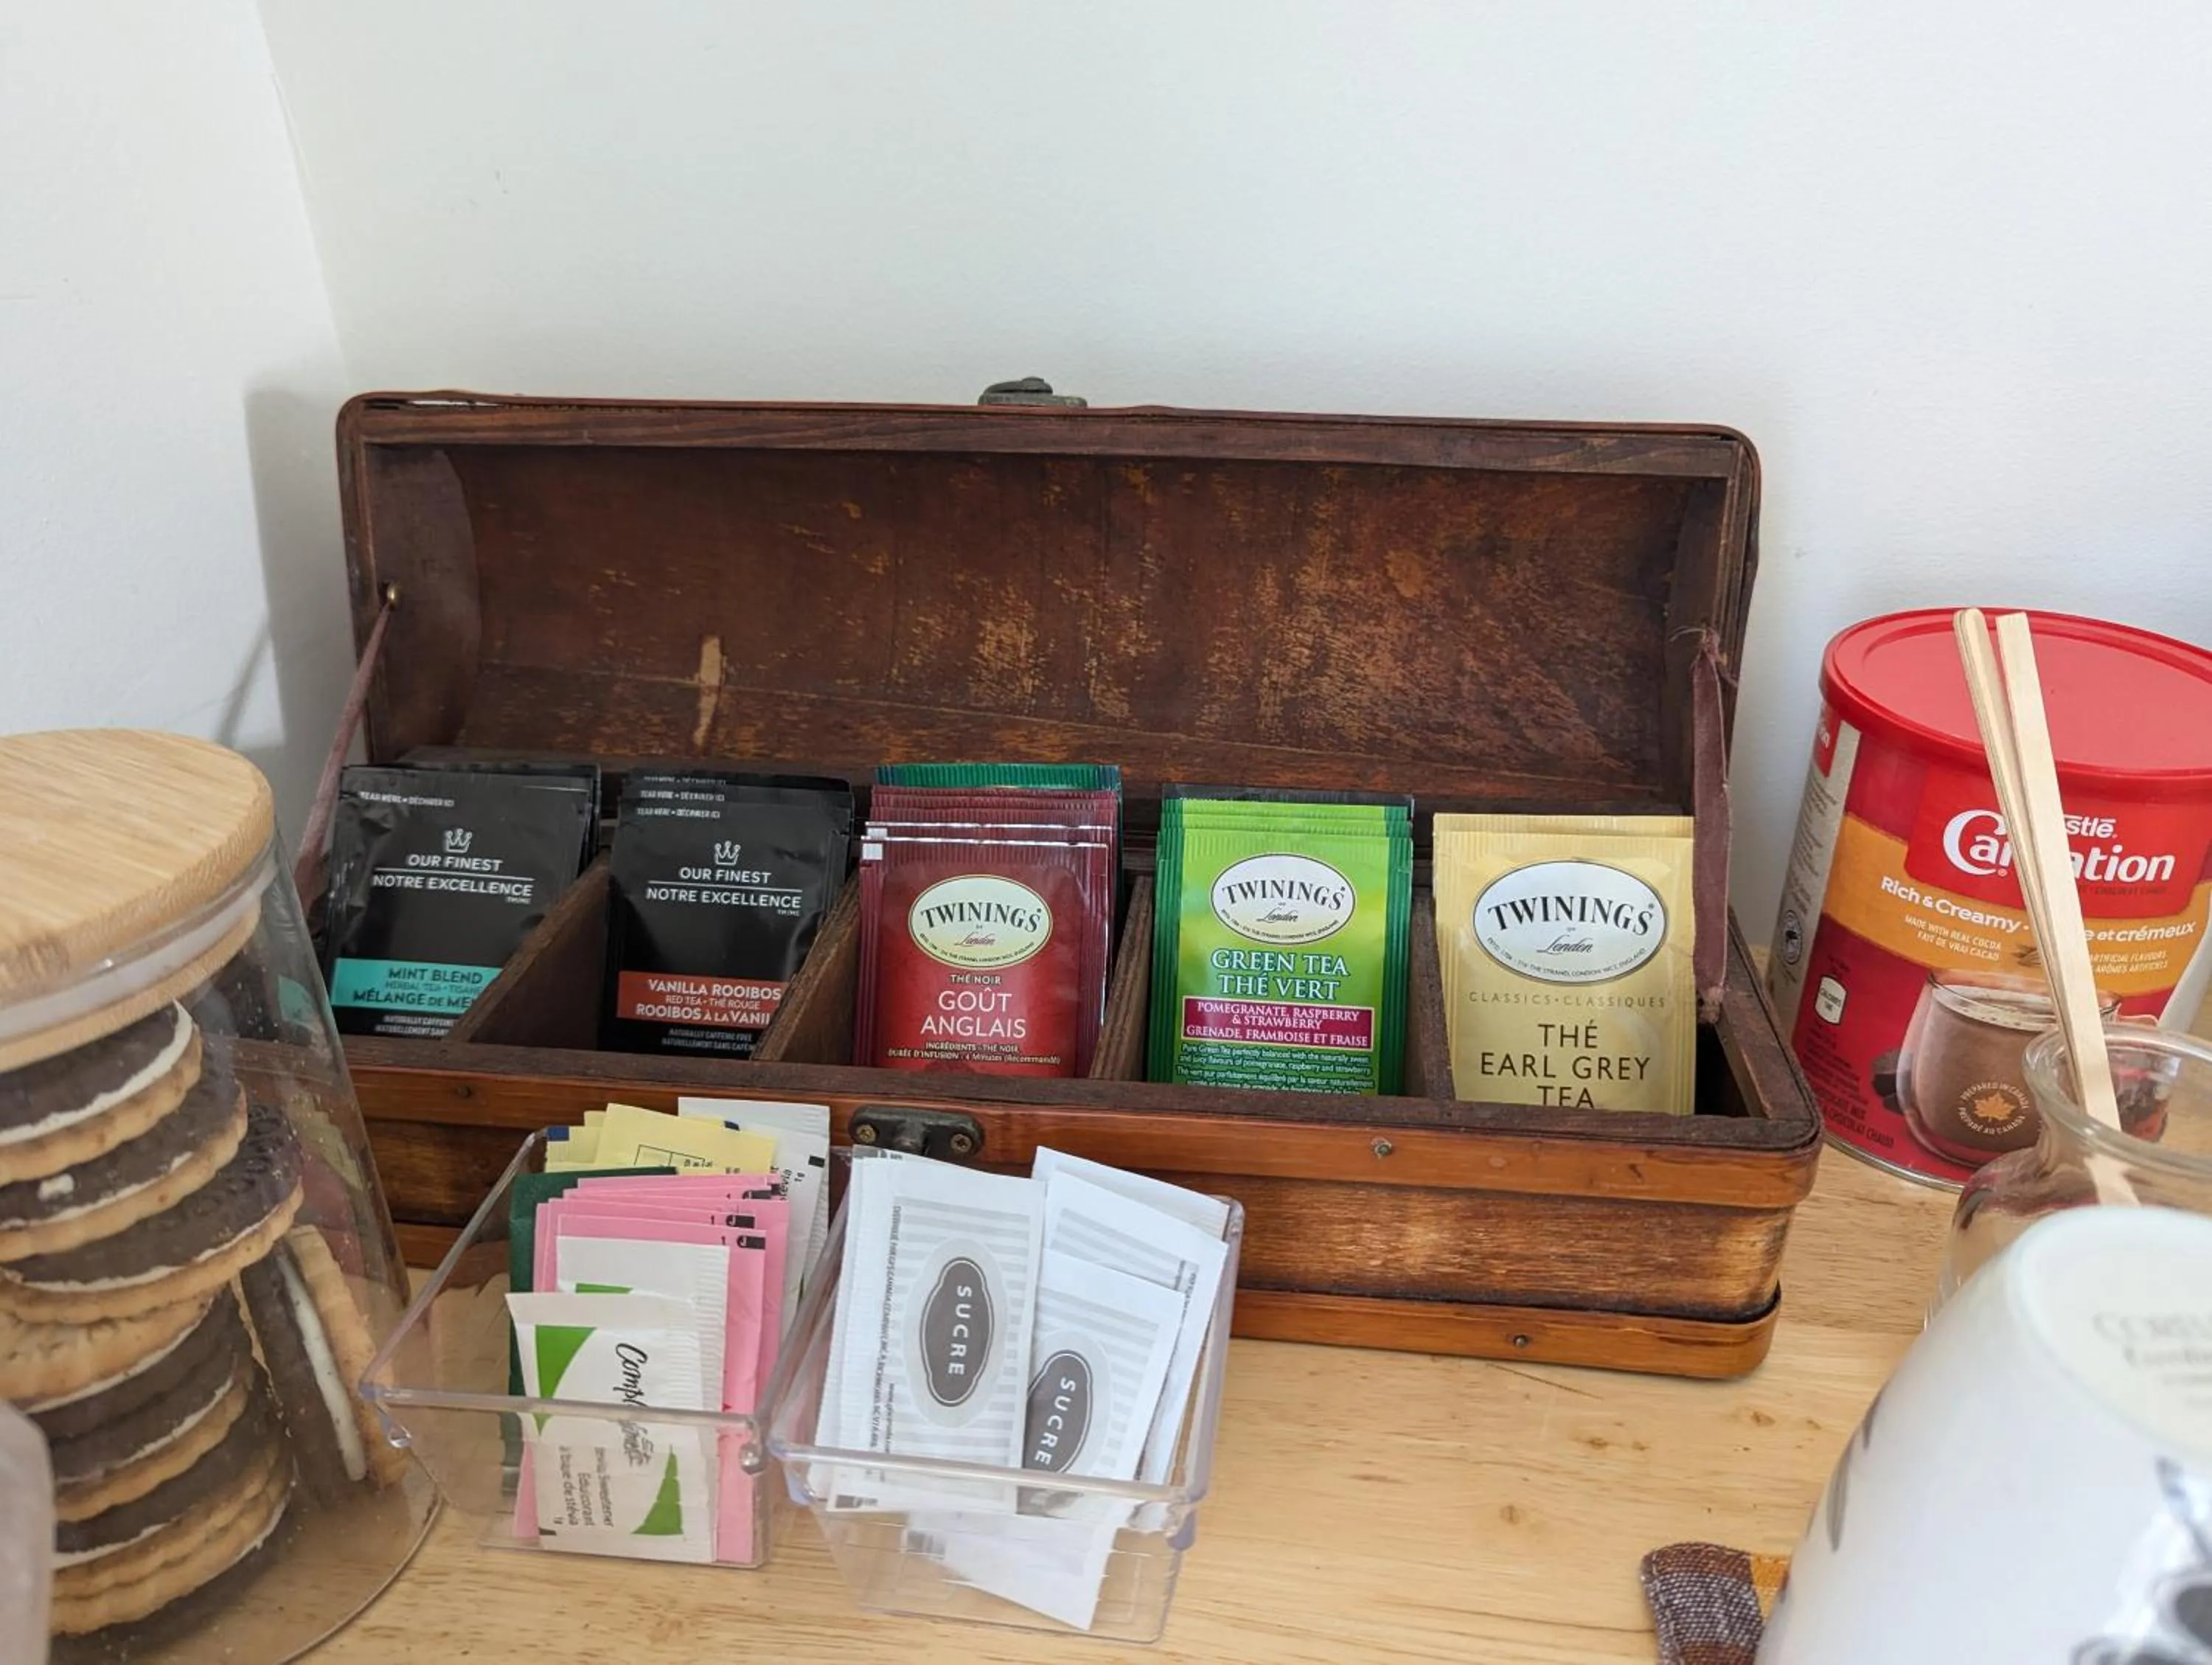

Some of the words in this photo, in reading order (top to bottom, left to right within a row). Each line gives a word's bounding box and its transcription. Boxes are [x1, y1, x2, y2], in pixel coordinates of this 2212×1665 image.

[1942, 810, 2175, 883] Cartion
[408, 854, 442, 866] OUR
[445, 856, 504, 872] FINEST
[373, 875, 425, 889] NOTRE
[428, 877, 534, 897] EXCELLENCE
[679, 867, 712, 880] OUR
[716, 869, 772, 884] FINEST
[646, 888, 698, 902] NOTRE
[701, 891, 802, 908] EXCELLENCE
[1222, 880, 1344, 911] TWININGS
[1881, 875, 1921, 905] Rich
[1922, 896, 1933, 908] &
[1935, 899, 2023, 934] Creamy
[920, 902, 1040, 933] TWININGS
[1487, 896, 1652, 936] TWININGS
[2097, 929, 2117, 941] et
[2115, 922, 2197, 942] crémeux
[1536, 934, 1593, 955] London
[1212, 950, 1295, 973] GREEN
[1304, 954, 1350, 976] TEA
[389, 967, 428, 980] MINT
[431, 970, 483, 984] BLEND
[950, 973, 970, 983] THÉ
[973, 976, 1001, 985] NOIR
[1218, 972, 1268, 995] THÉ
[1274, 978, 1340, 1000] VERT
[352, 987, 426, 1006] MÉLANGE
[428, 996, 443, 1007] DE
[647, 979, 709, 995] VANILLA
[712, 984, 782, 1001] ROOIBOS
[939, 987, 1012, 1012] GOÛT
[636, 1004, 701, 1019] ROOIBOS
[714, 1013, 729, 1023] LA
[665, 995, 684, 1004] RED
[685, 996, 702, 1005] TEA
[728, 1000, 761, 1010] ROUGE
[1231, 1015, 1242, 1025] &
[1245, 1016, 1322, 1030] STRAWBERRY
[1293, 1007, 1360, 1021] RASPBERRY
[920, 1015, 1026, 1038] ANGLAIS
[1245, 1029, 1310, 1043] FRAMBOISE
[1312, 1033, 1327, 1043] ET
[1329, 1035, 1368, 1046] FRAISE
[1537, 1019, 1598, 1049] THÉ
[1481, 1052, 1556, 1079] EARL
[1572, 1055, 1650, 1080] GREY
[1537, 1085, 1595, 1108] TEA
[947, 1285, 973, 1376] SUCRE
[1035, 1377, 1077, 1465] SUCRE
